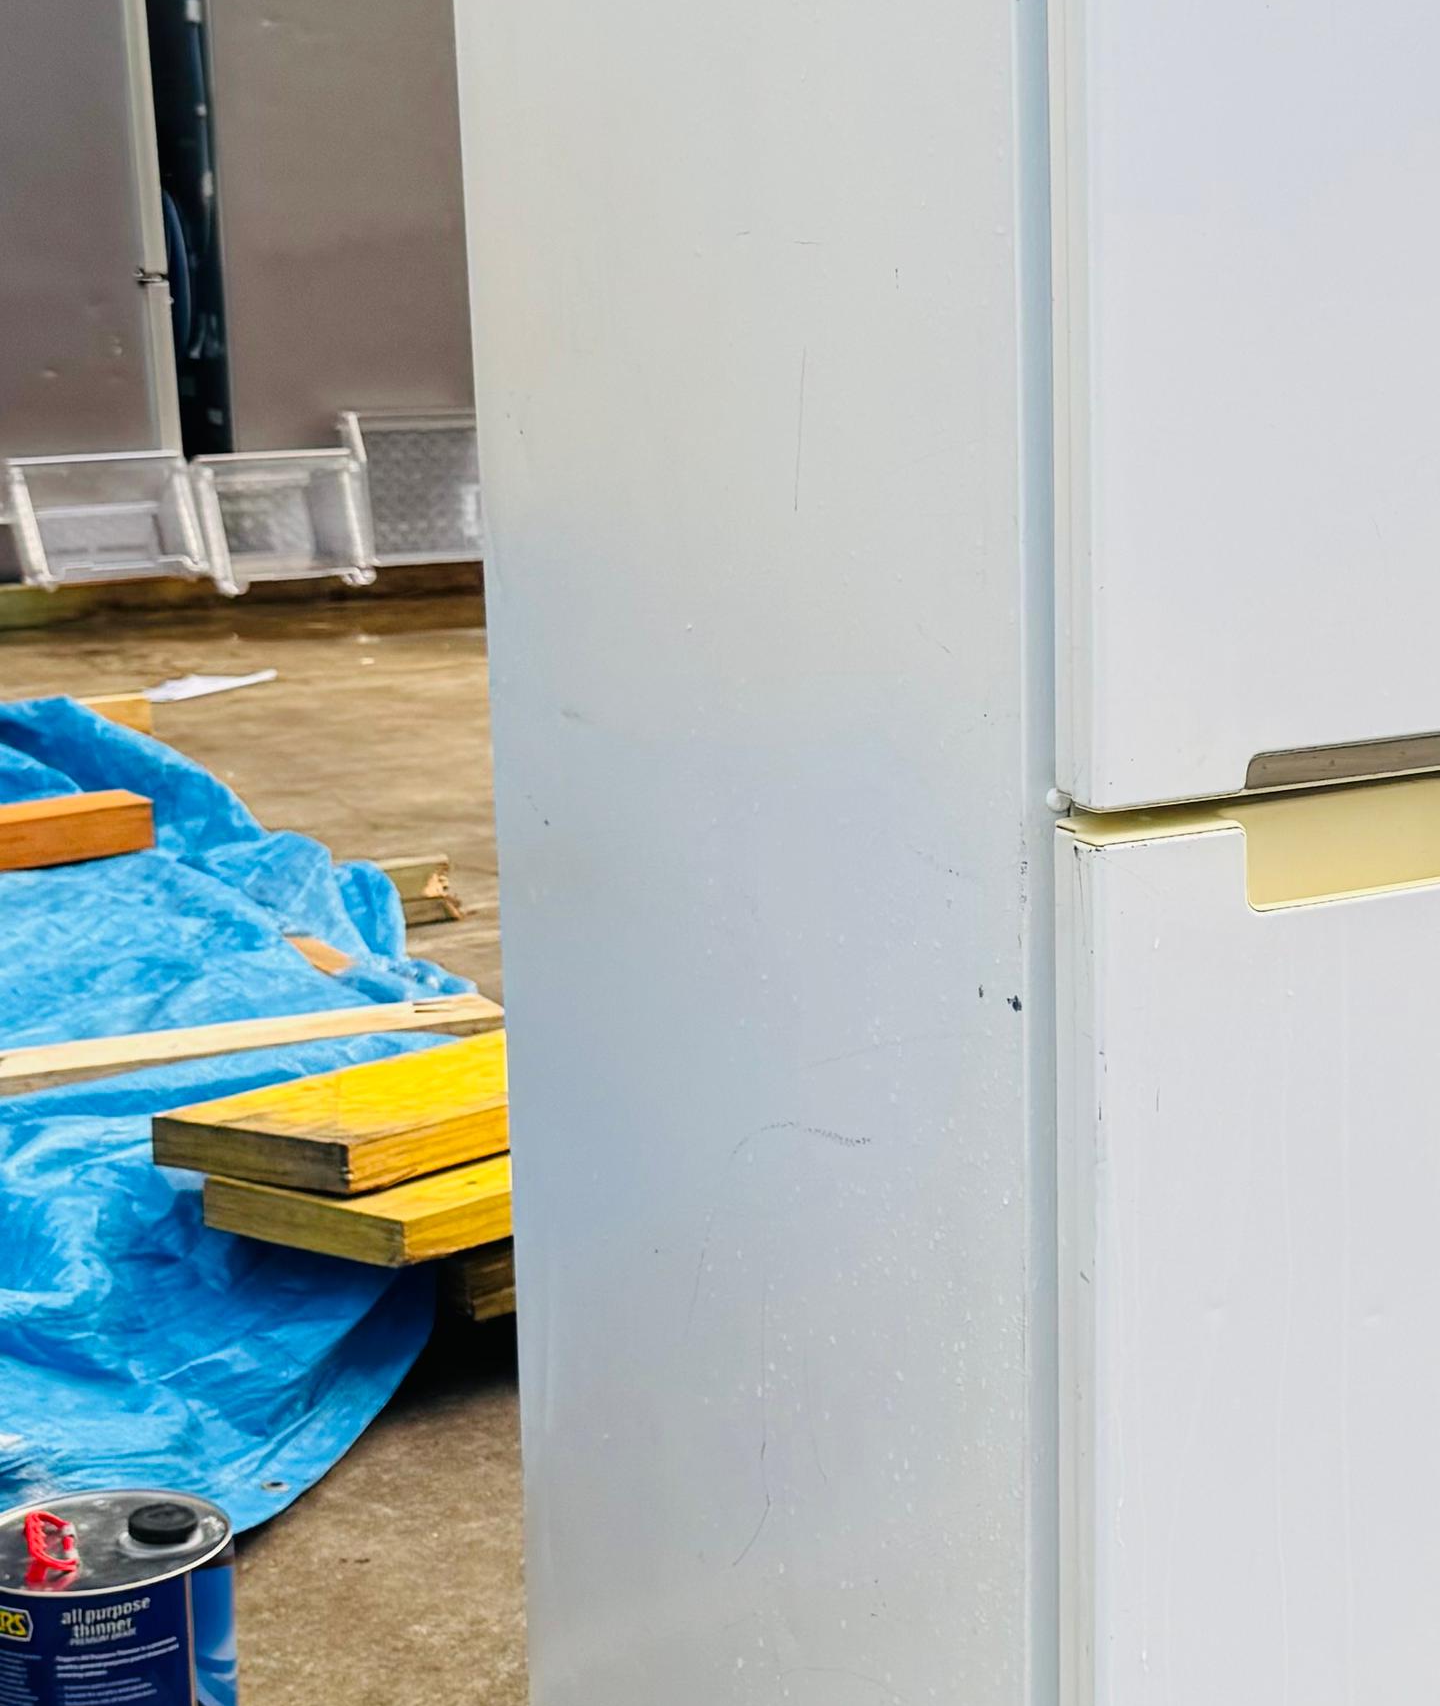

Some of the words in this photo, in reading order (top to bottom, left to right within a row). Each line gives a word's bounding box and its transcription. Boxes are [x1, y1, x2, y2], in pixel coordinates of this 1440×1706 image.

[61, 1608, 82, 1625] all
[85, 1597, 151, 1624] purpose
[72, 1617, 132, 1638] thinner
